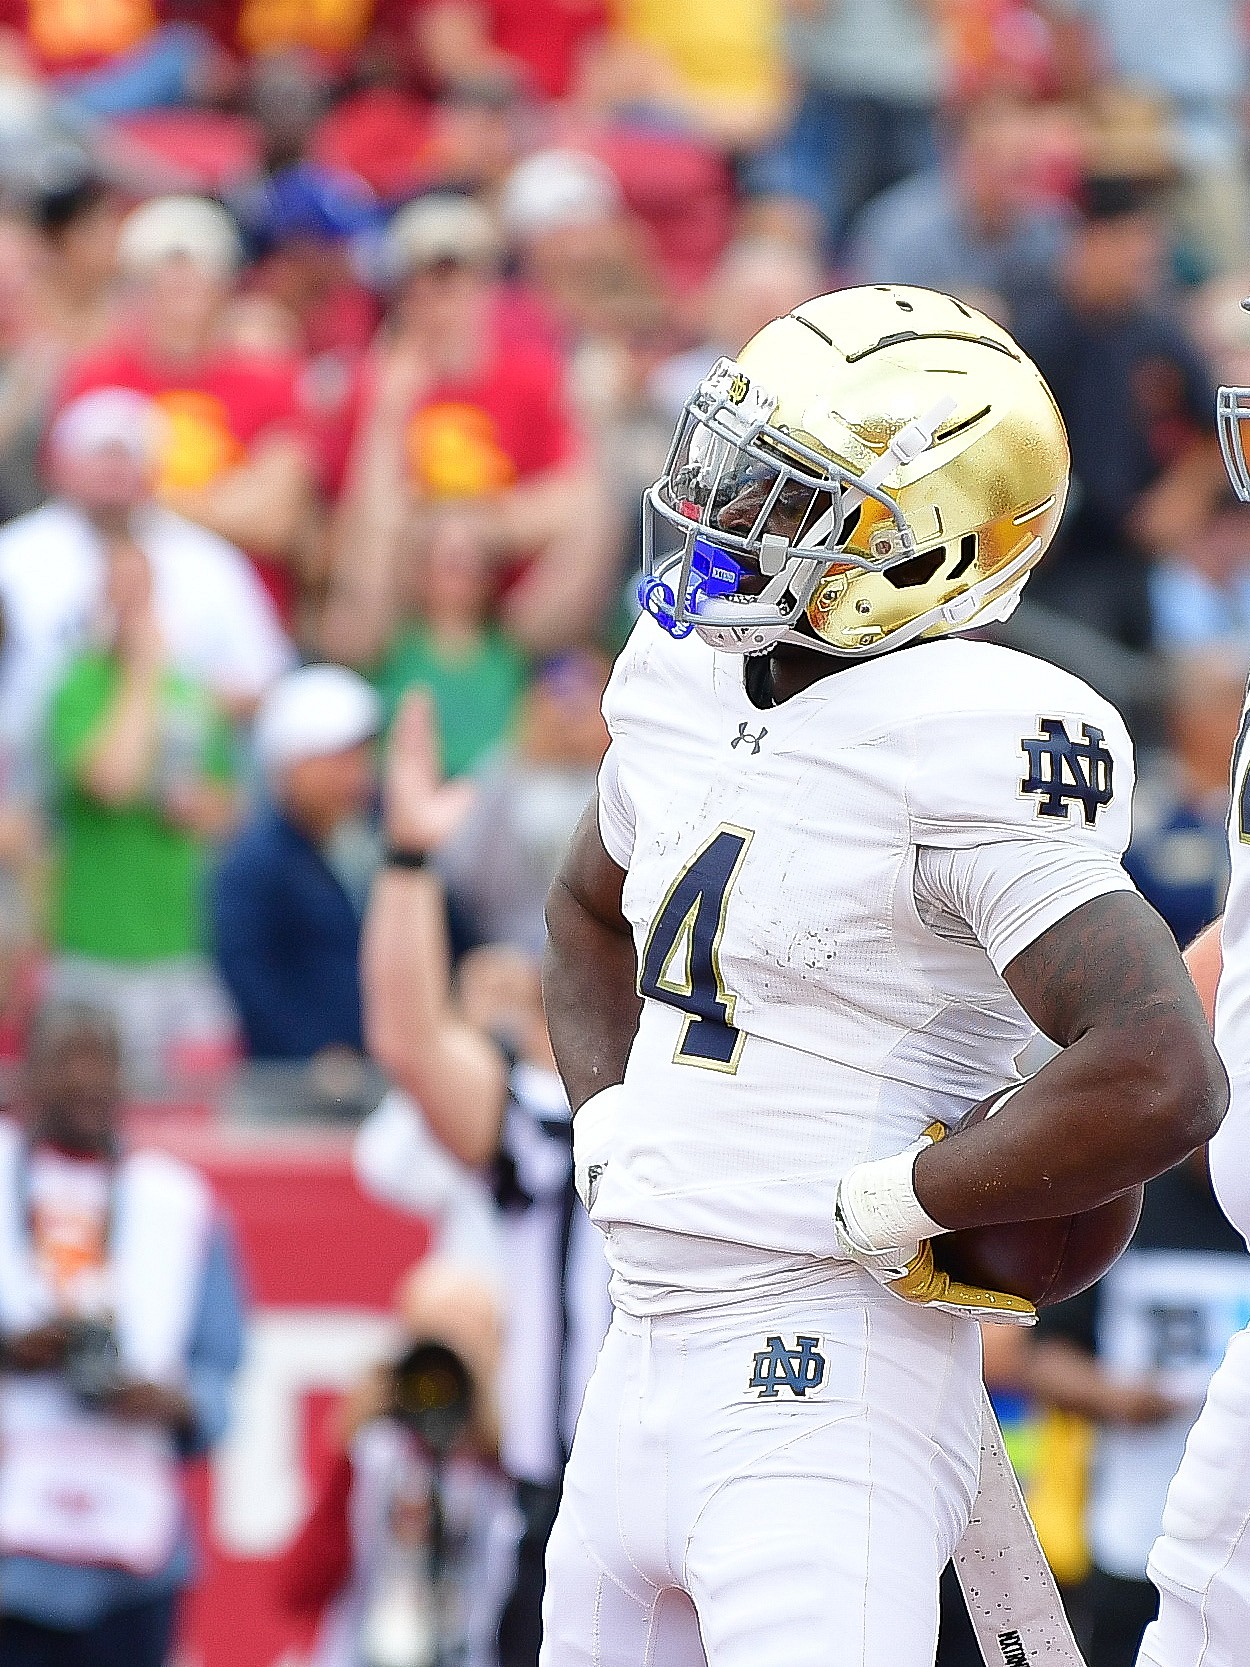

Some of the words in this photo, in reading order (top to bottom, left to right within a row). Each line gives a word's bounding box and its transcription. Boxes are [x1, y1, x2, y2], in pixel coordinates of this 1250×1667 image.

[1018, 716, 1116, 825] ND
[636, 821, 755, 1076] 4
[748, 1334, 827, 1399] ND
